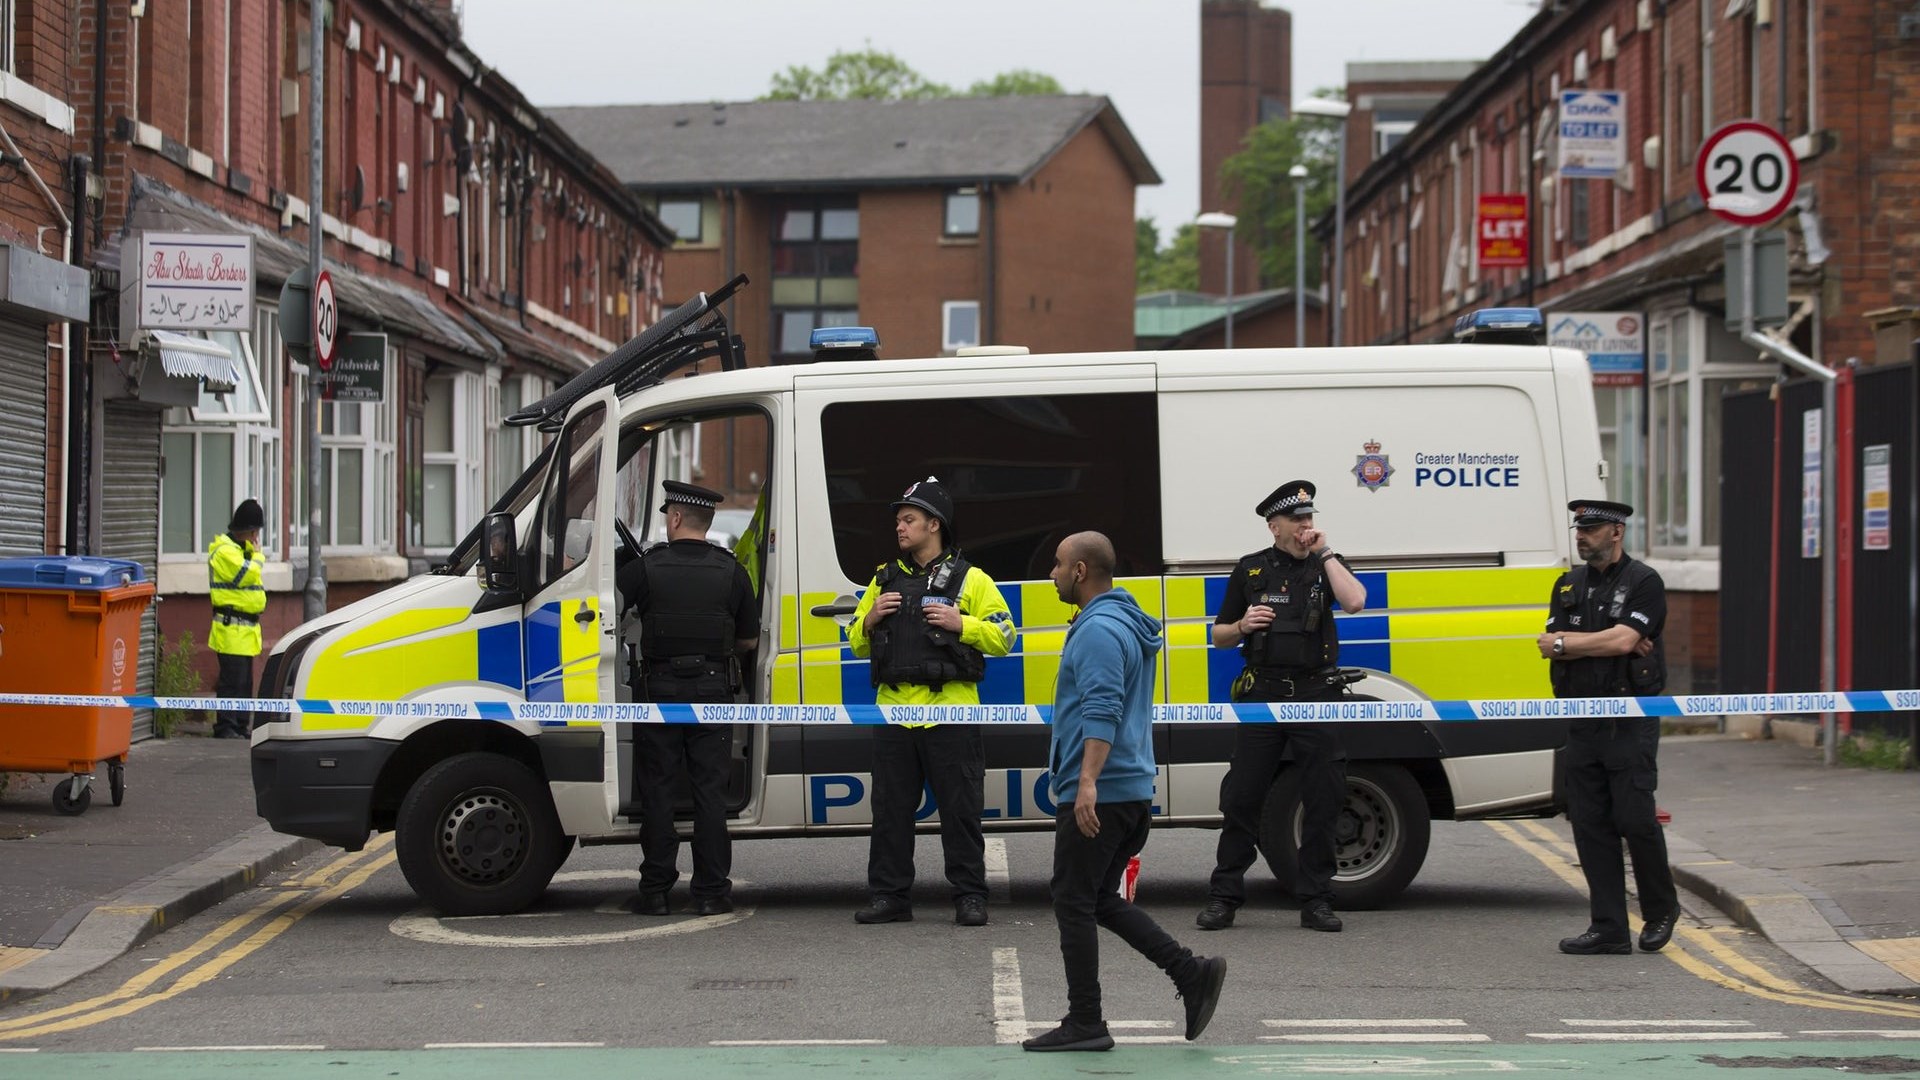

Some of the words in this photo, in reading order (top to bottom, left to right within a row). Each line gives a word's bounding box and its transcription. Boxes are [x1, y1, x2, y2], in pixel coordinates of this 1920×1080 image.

[1562, 123, 1585, 137] TO
[1588, 123, 1617, 137] LET
[1713, 153, 1783, 194] 20
[1483, 220, 1526, 239] LET
[207, 252, 247, 282] Barbers
[318, 297, 331, 342] 20
[1415, 452, 1455, 465] Greater
[1457, 452, 1519, 465] Manchester
[1415, 467, 1519, 487] POLICE
[236, 700, 256, 710] LINE
[257, 700, 290, 712] POLICE
[1589, 699, 1627, 715] POLICE
[1686, 697, 1722, 713] CROSS
[1726, 696, 1748, 712] NOT
[1751, 696, 1766, 711] DO
[1769, 695, 1794, 710] LINE
[1796, 694, 1835, 710] POLICE
[1896, 691, 1920, 708] OSS
[340, 702, 372, 714] CROSS
[375, 702, 393, 715] NOT
[397, 703, 409, 715] DO
[411, 703, 433, 716] LINE
[434, 703, 468, 716] POLICE
[519, 703, 551, 717] CROSS
[553, 703, 573, 718] NOT
[575, 704, 590, 719] DO
[592, 704, 613, 719] LINE
[615, 705, 649, 719] POLICE
[702, 705, 735, 720] CROSS
[737, 705, 757, 720] NOT
[760, 706, 774, 721] DO
[777, 706, 799, 721] LINE
[801, 706, 836, 721] POLICE
[890, 706, 924, 721] CROSS
[927, 707, 947, 721] NOT
[950, 707, 963, 722] DO
[967, 707, 989, 722] LINE
[991, 706, 1027, 722] POLICE
[1161, 705, 1184, 720] LINE
[1187, 704, 1223, 720] POLICE
[1280, 704, 1315, 719] CROSS
[1318, 704, 1339, 719] NOT
[1342, 704, 1357, 719] DO
[1360, 704, 1383, 718] LINE
[1386, 703, 1423, 718] POLICE
[1481, 701, 1516, 716] CROSS
[1520, 701, 1541, 716] NOT
[1544, 700, 1559, 715] DO
[1563, 700, 1586, 715] LINE
